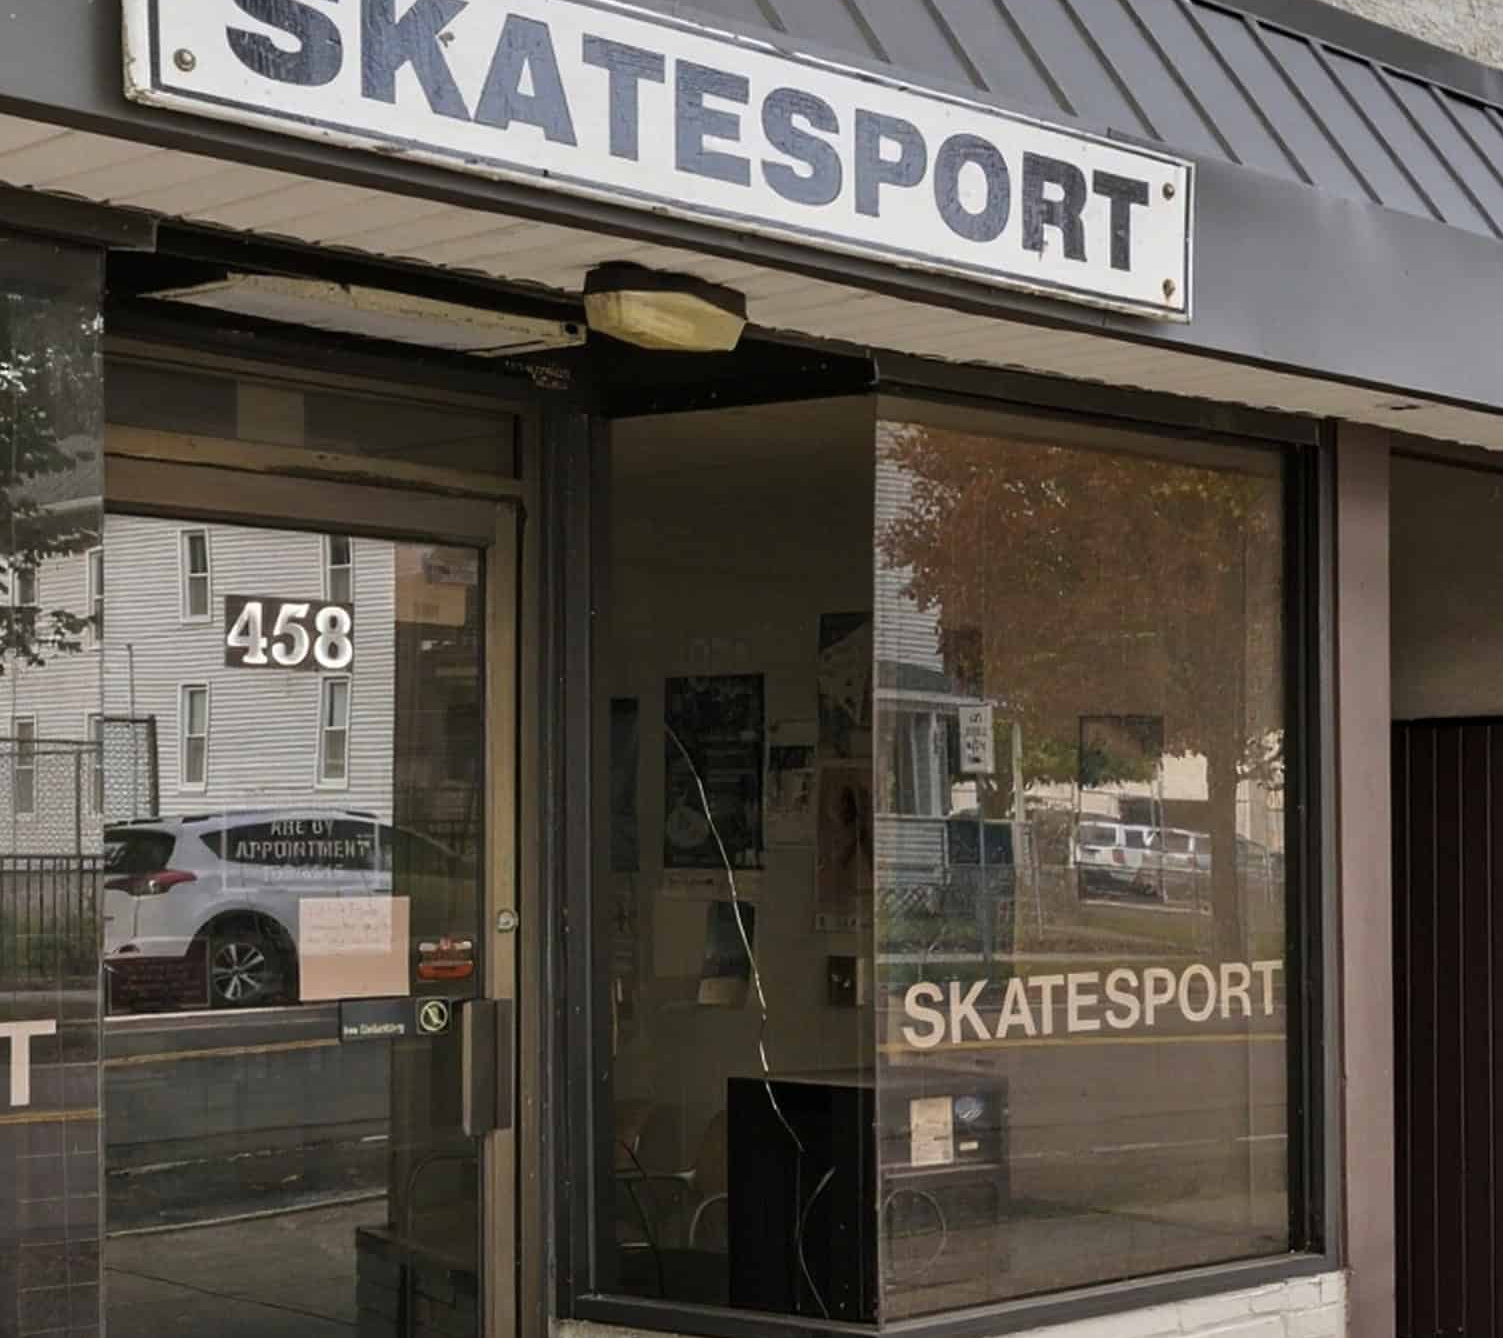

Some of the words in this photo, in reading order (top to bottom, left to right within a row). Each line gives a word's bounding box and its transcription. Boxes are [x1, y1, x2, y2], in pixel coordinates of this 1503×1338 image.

[227, 601, 353, 669] 458
[235, 840, 372, 860] APPOINTMENT
[901, 960, 1285, 1050] SKATESPORT
